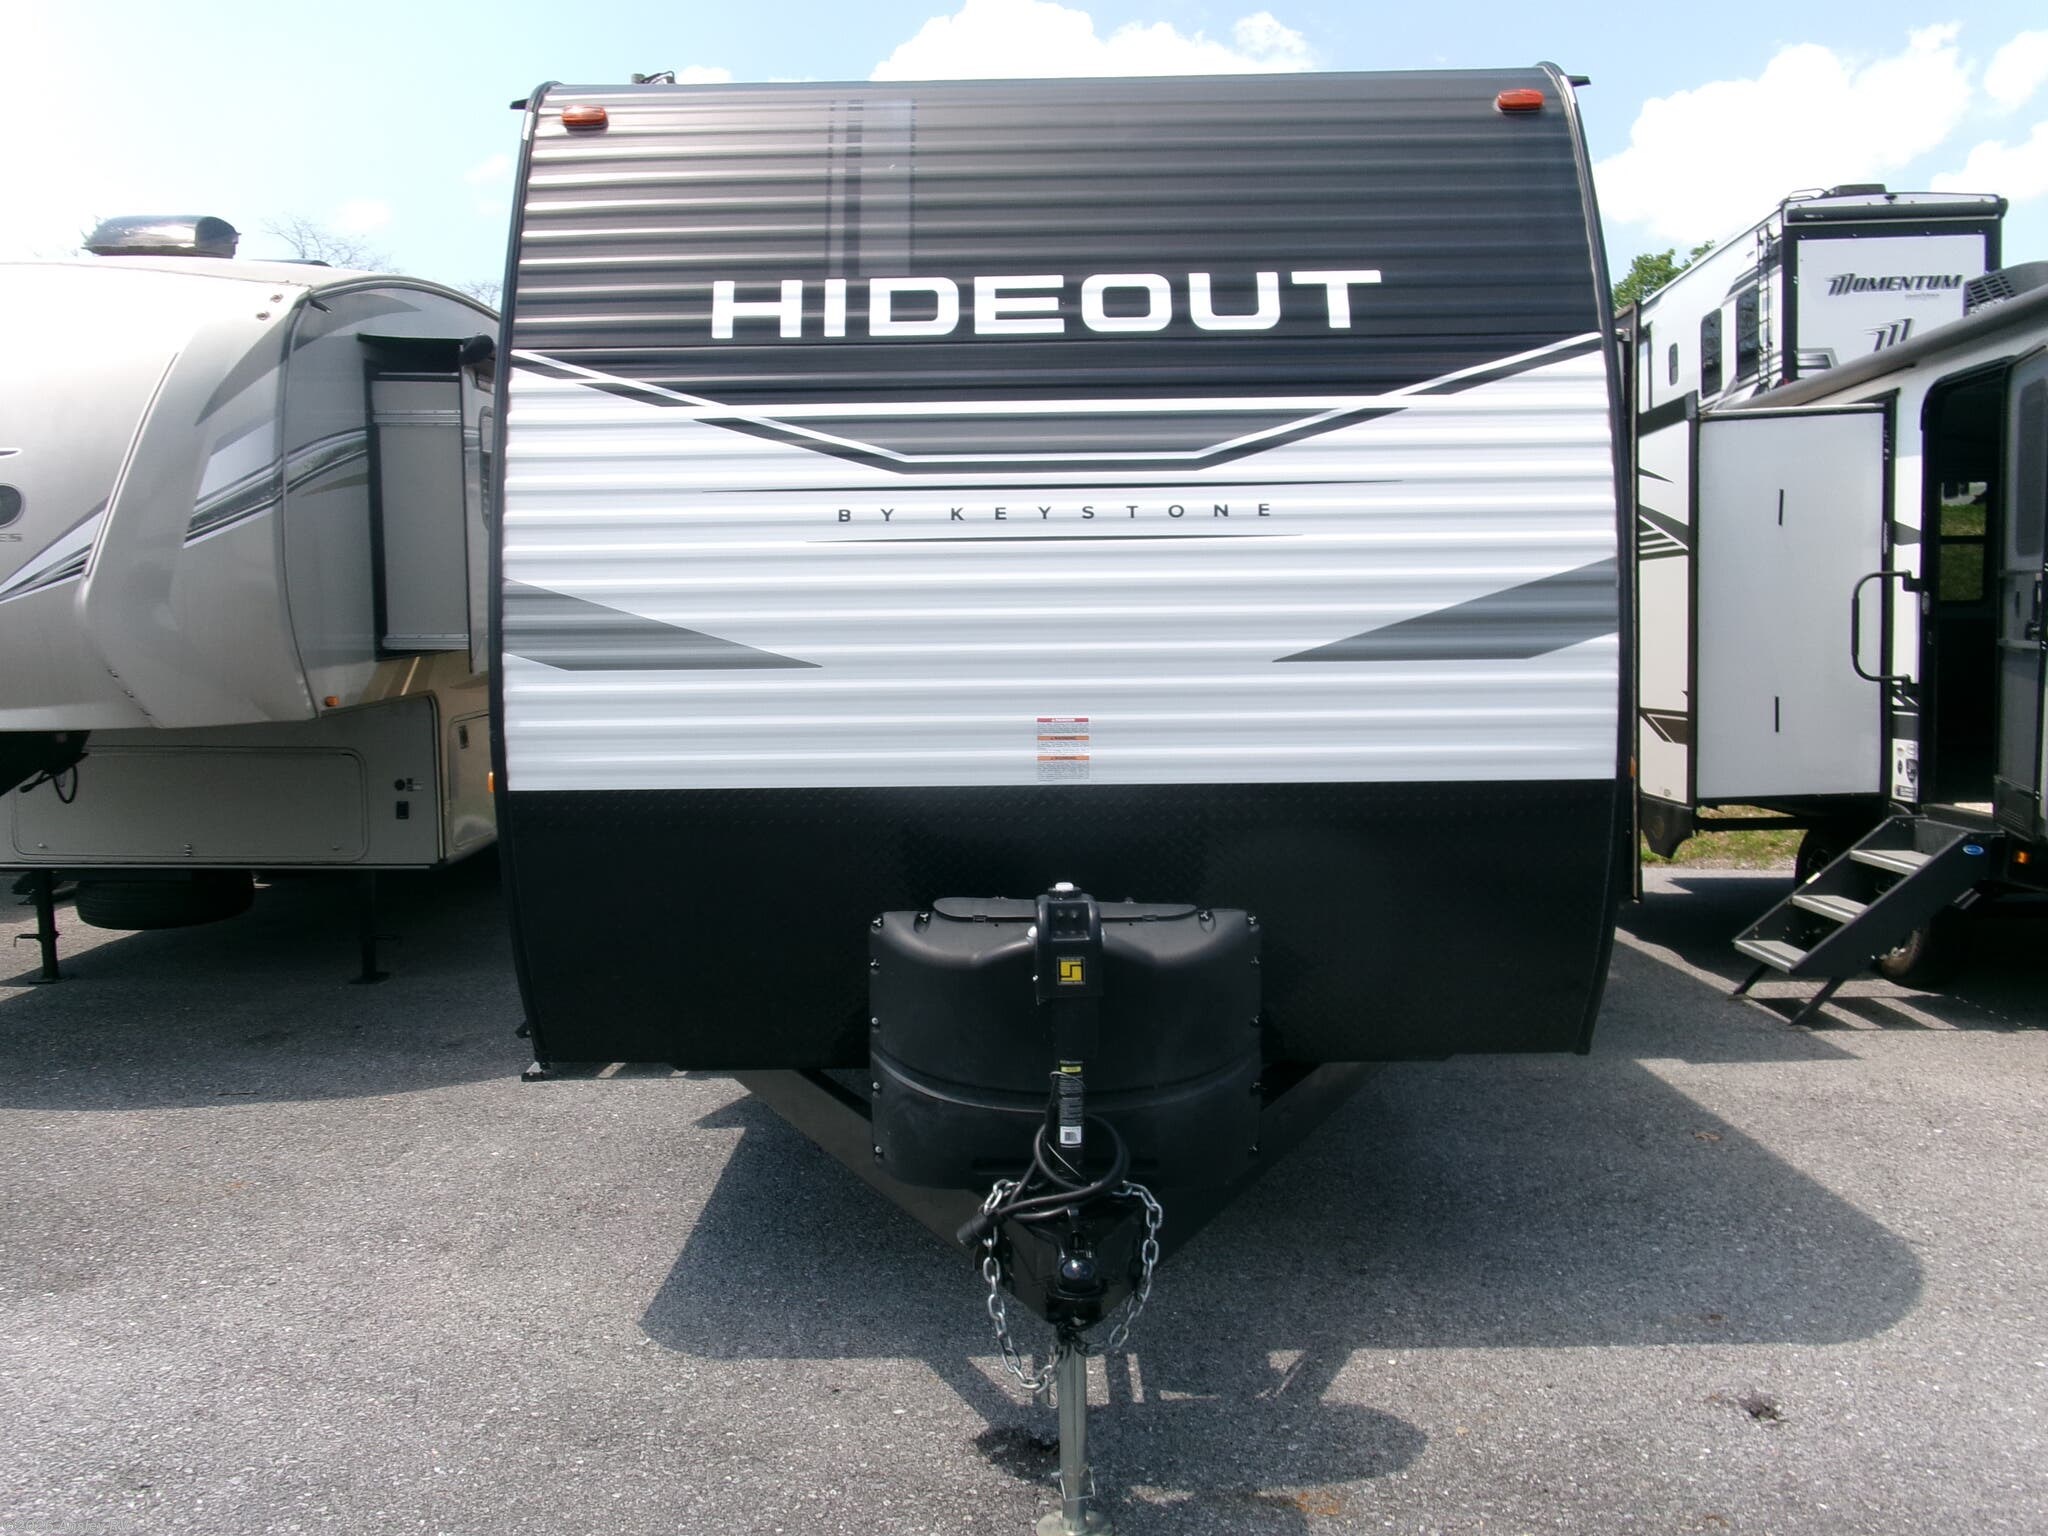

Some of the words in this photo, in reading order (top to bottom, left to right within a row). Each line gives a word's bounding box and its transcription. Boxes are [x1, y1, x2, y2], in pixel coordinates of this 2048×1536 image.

[1826, 273, 1963, 296] MOMENTUM
[711, 270, 1382, 339] HIDEOUT
[838, 508, 894, 523] BY
[951, 503, 1271, 521] KEYSTONE
